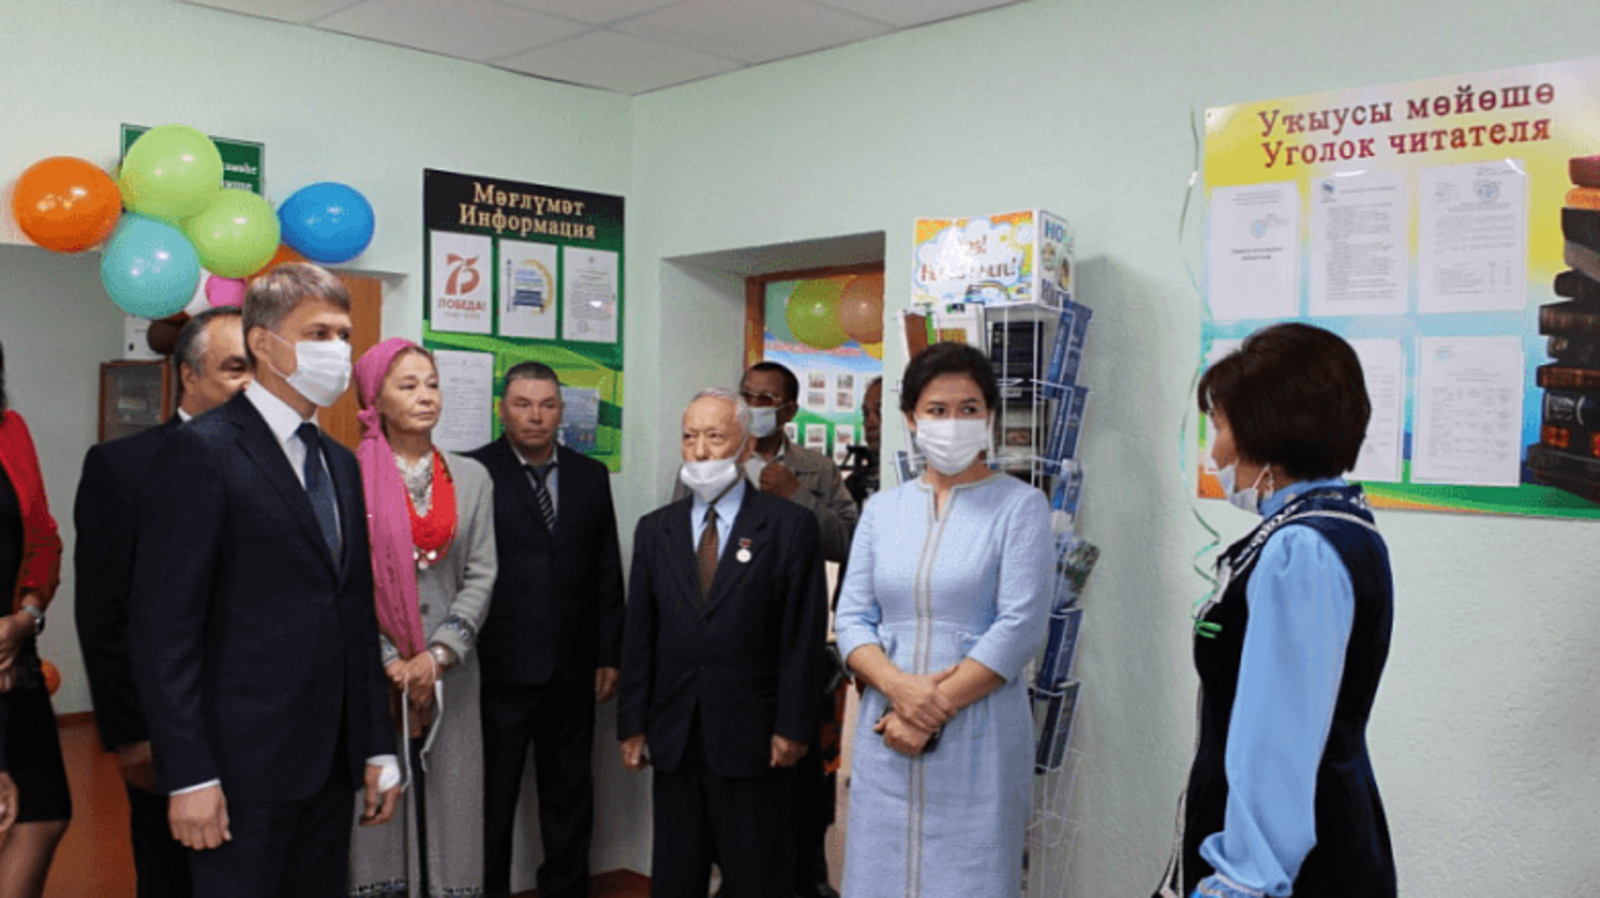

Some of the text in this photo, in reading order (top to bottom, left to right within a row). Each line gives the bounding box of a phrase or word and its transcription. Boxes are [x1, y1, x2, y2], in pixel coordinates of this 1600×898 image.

[1407, 83, 1556, 119] мөйөшө
[1261, 118, 1551, 168] Уголок читателя
[459, 204, 596, 239] Информация
[445, 253, 481, 295] 75
